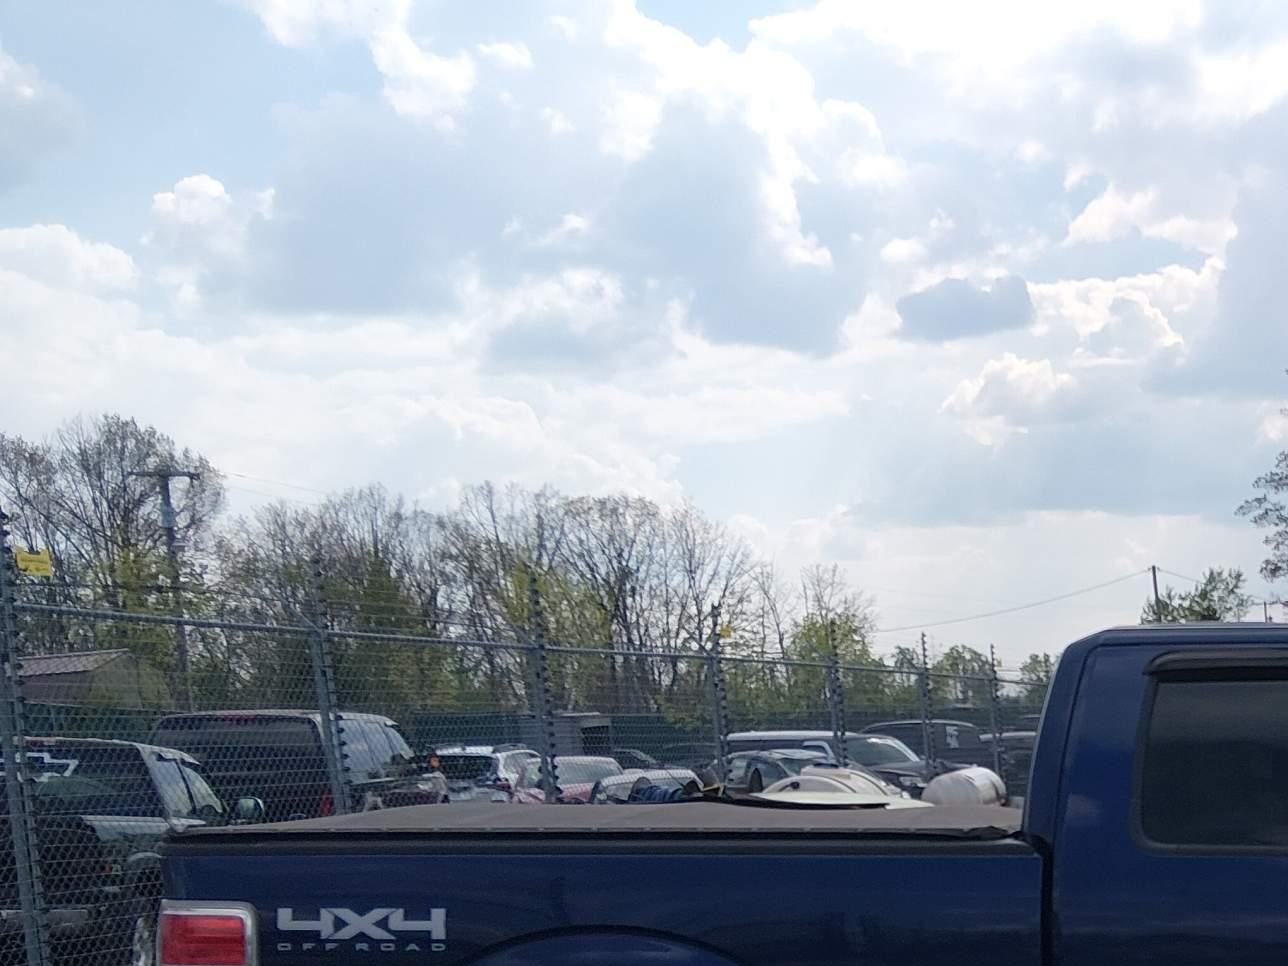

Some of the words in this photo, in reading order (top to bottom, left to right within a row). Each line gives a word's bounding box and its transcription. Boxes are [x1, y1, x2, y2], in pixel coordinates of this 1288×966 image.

[276, 907, 447, 940] 4X4
[277, 942, 339, 952] OFF
[355, 942, 447, 952] ROAD
